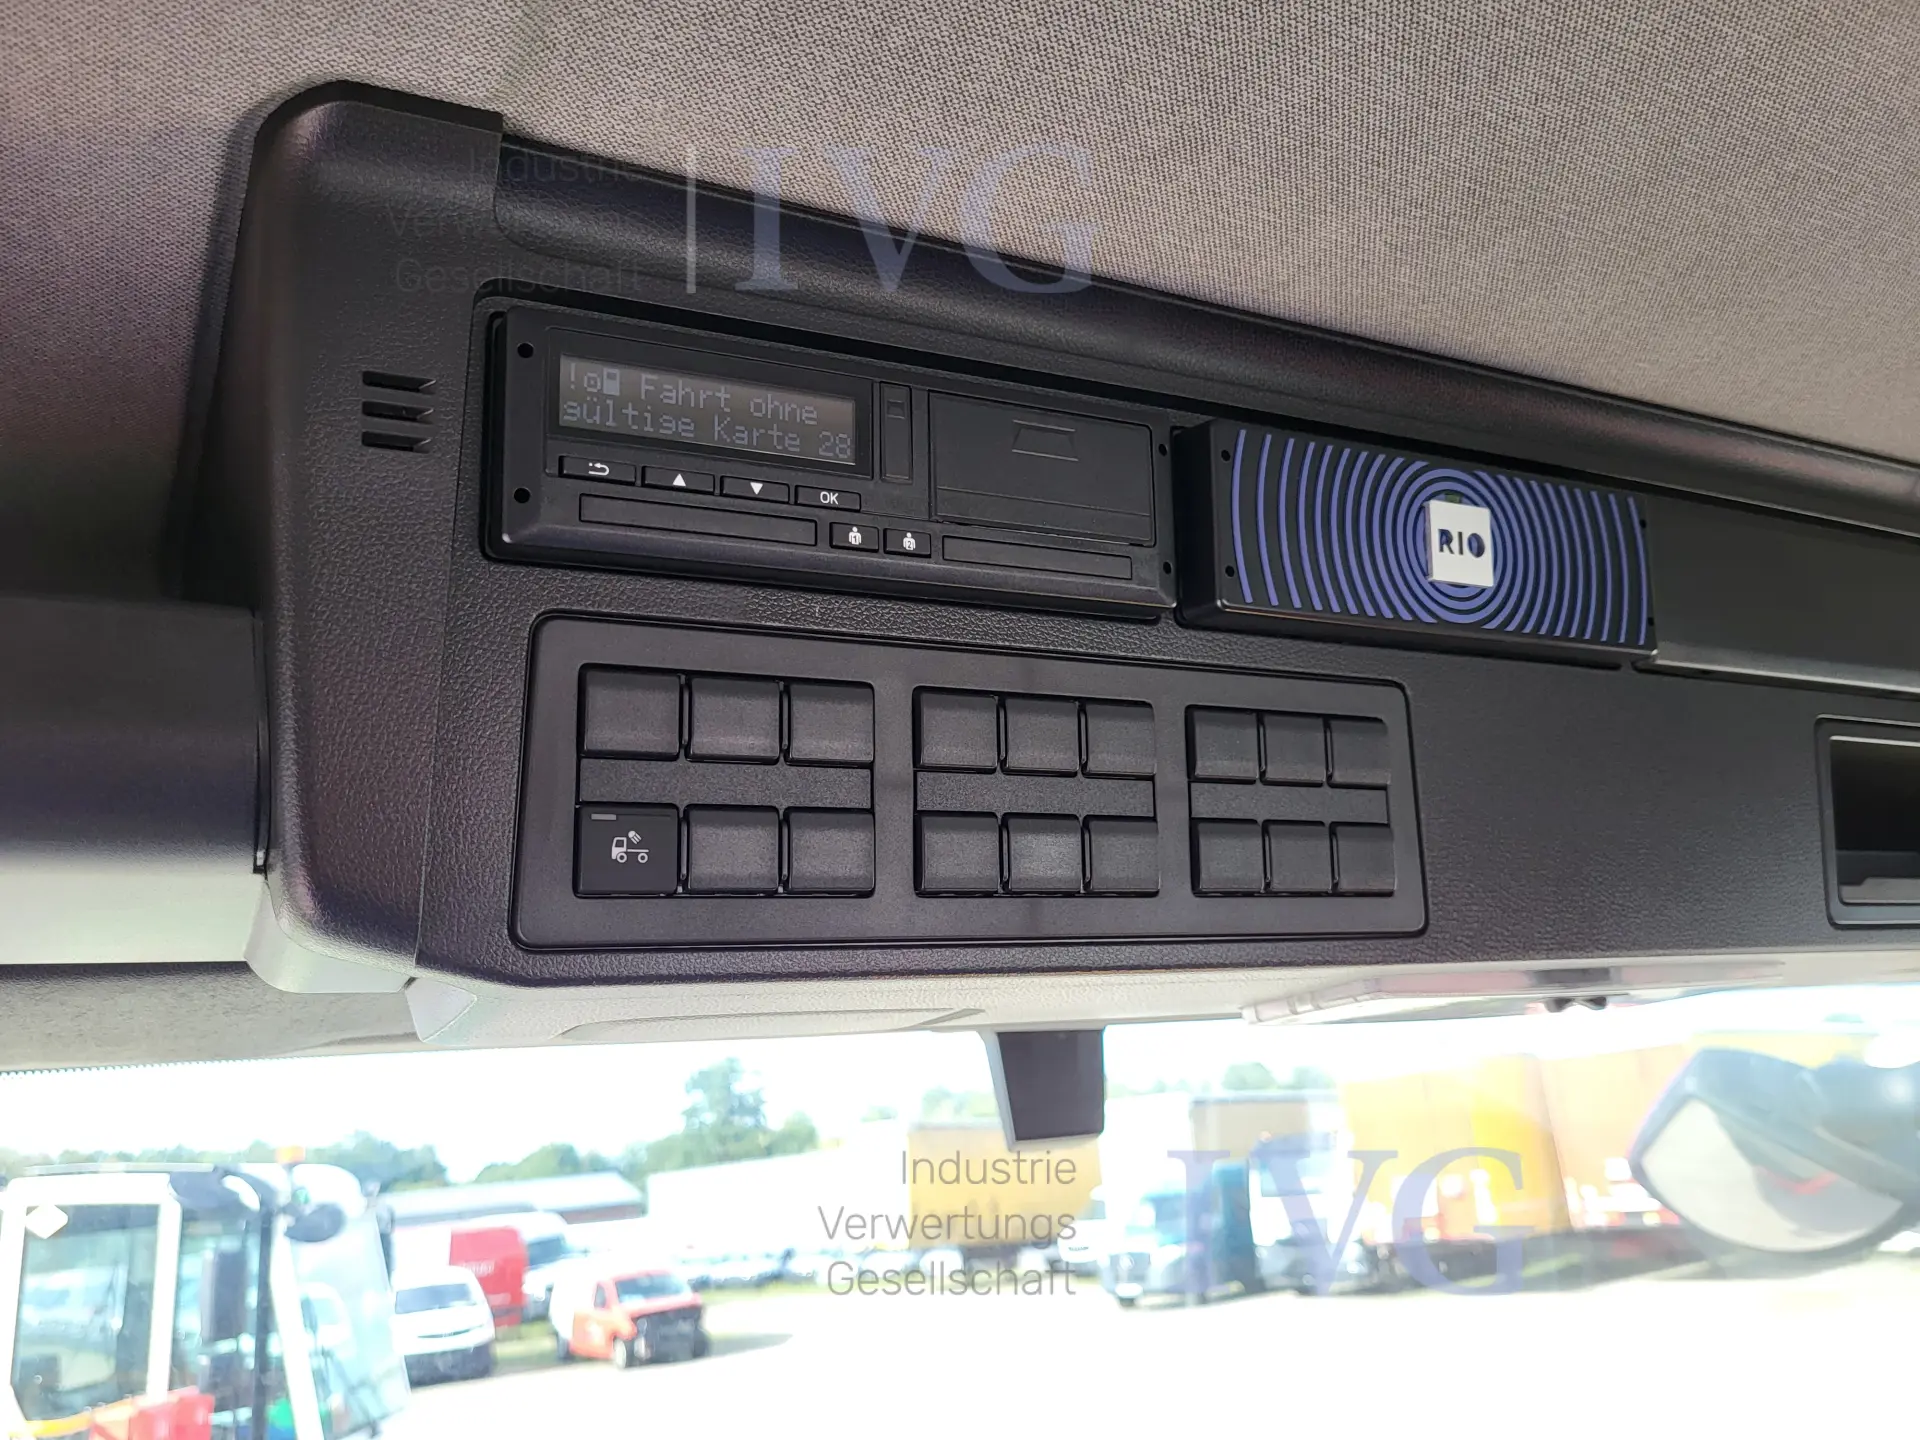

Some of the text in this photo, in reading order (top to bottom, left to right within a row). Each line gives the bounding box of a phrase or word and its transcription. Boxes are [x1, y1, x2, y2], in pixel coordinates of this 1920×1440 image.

[641, 373, 731, 413] Fahrt
[749, 393, 818, 426] ohne
[713, 413, 801, 453] Karte
[818, 430, 852, 459] 28
[819, 491, 839, 505] OK
[1437, 528, 1486, 559] RIO
